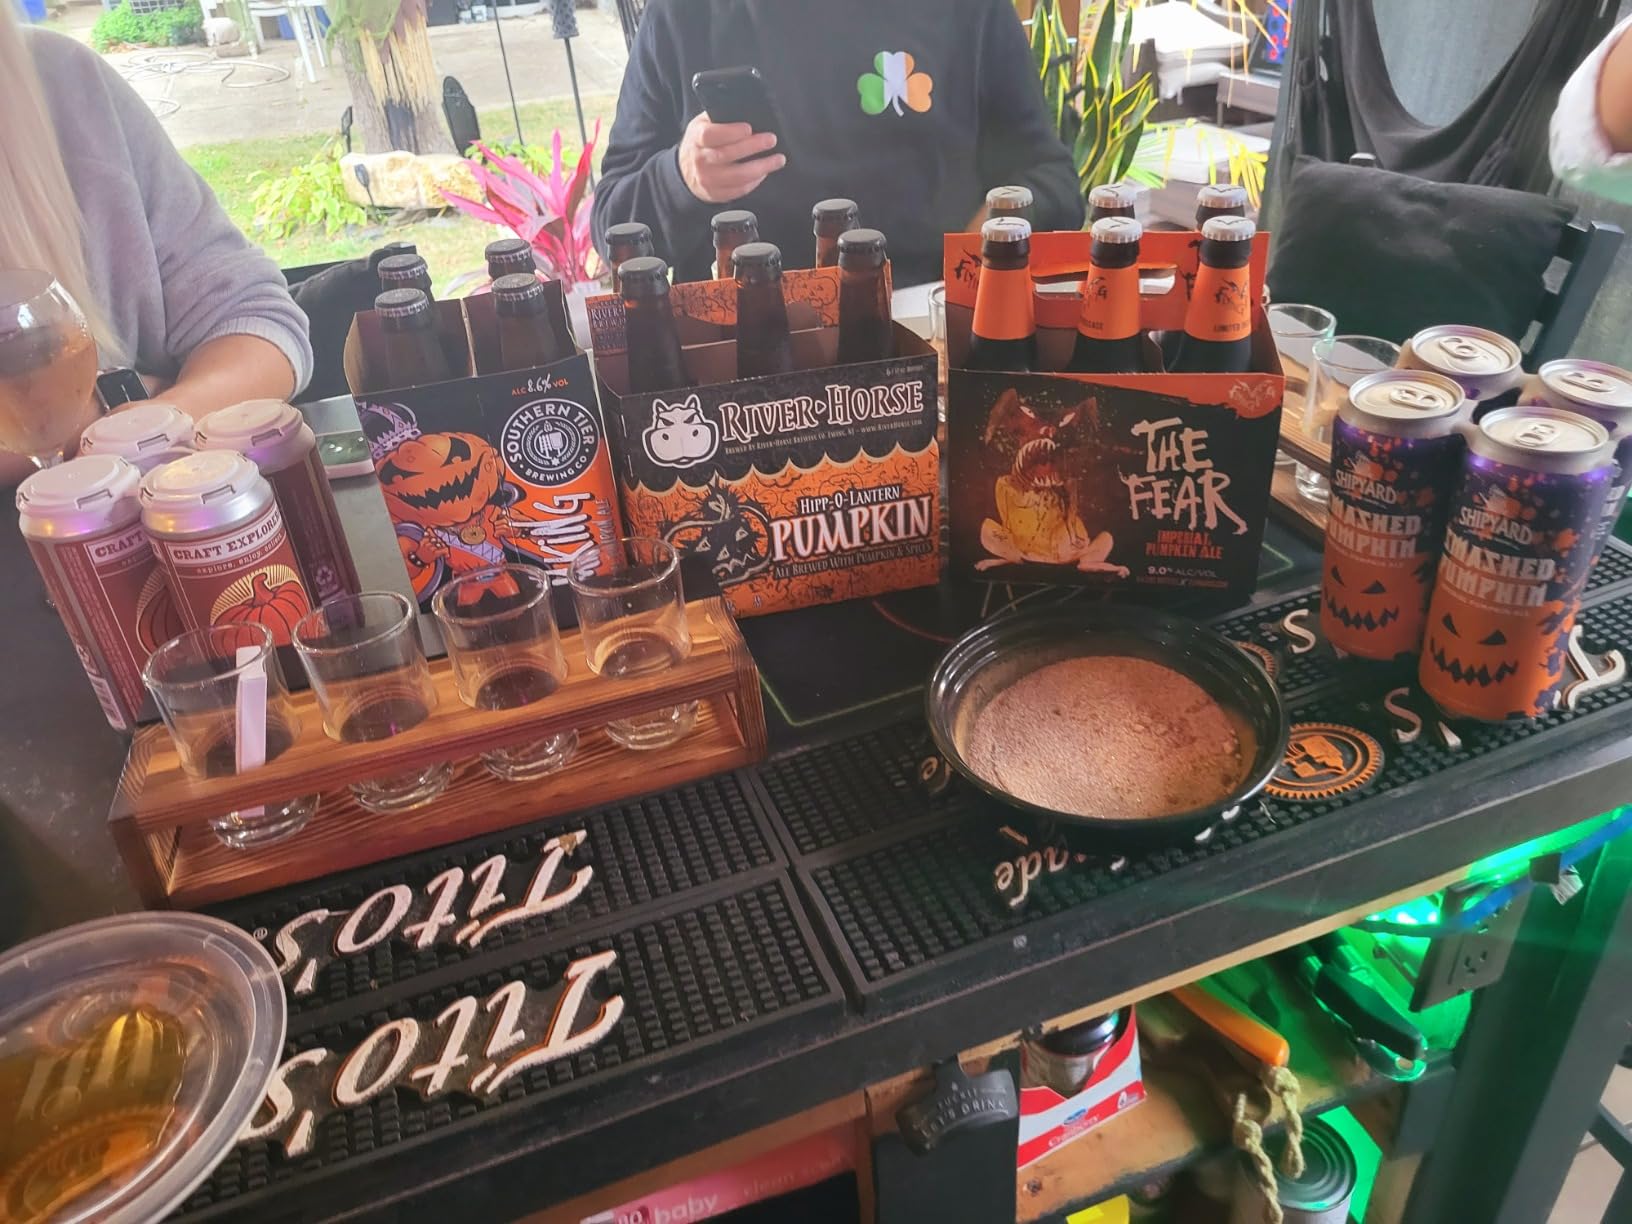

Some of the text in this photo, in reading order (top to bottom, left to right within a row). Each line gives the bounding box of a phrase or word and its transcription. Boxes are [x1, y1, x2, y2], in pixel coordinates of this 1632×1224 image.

[512, 373, 568, 396] ALC 8.6% VOL
[719, 381, 924, 443] RIVER HORSE
[507, 403, 595, 463] SOUTHERN TIER
[1131, 416, 1213, 473] THE
[525, 455, 587, 481] BREWING CO
[800, 485, 900, 514] HIPP-O-LANTERN
[1120, 469, 1248, 535] FEAR
[1335, 468, 1397, 505] SHIPYARD
[770, 495, 932, 562] PUMPKIN
[1157, 530, 1211, 545] IMPERIAL
[1458, 505, 1533, 545] SHIPYARD
[95, 531, 143, 558] CRAFT
[173, 545, 222, 560] CRAFT
[793, 561, 828, 575] BREWED
[829, 556, 854, 568] WITH
[856, 550, 895, 564] PUMPKIN
[905, 542, 932, 555] SPICES
[1145, 542, 1224, 560] PUMPKIN ALE
[270, 829, 593, 994] Tito's
[237, 950, 625, 1157] Tito's
[654, 1193, 719, 1224] baby
